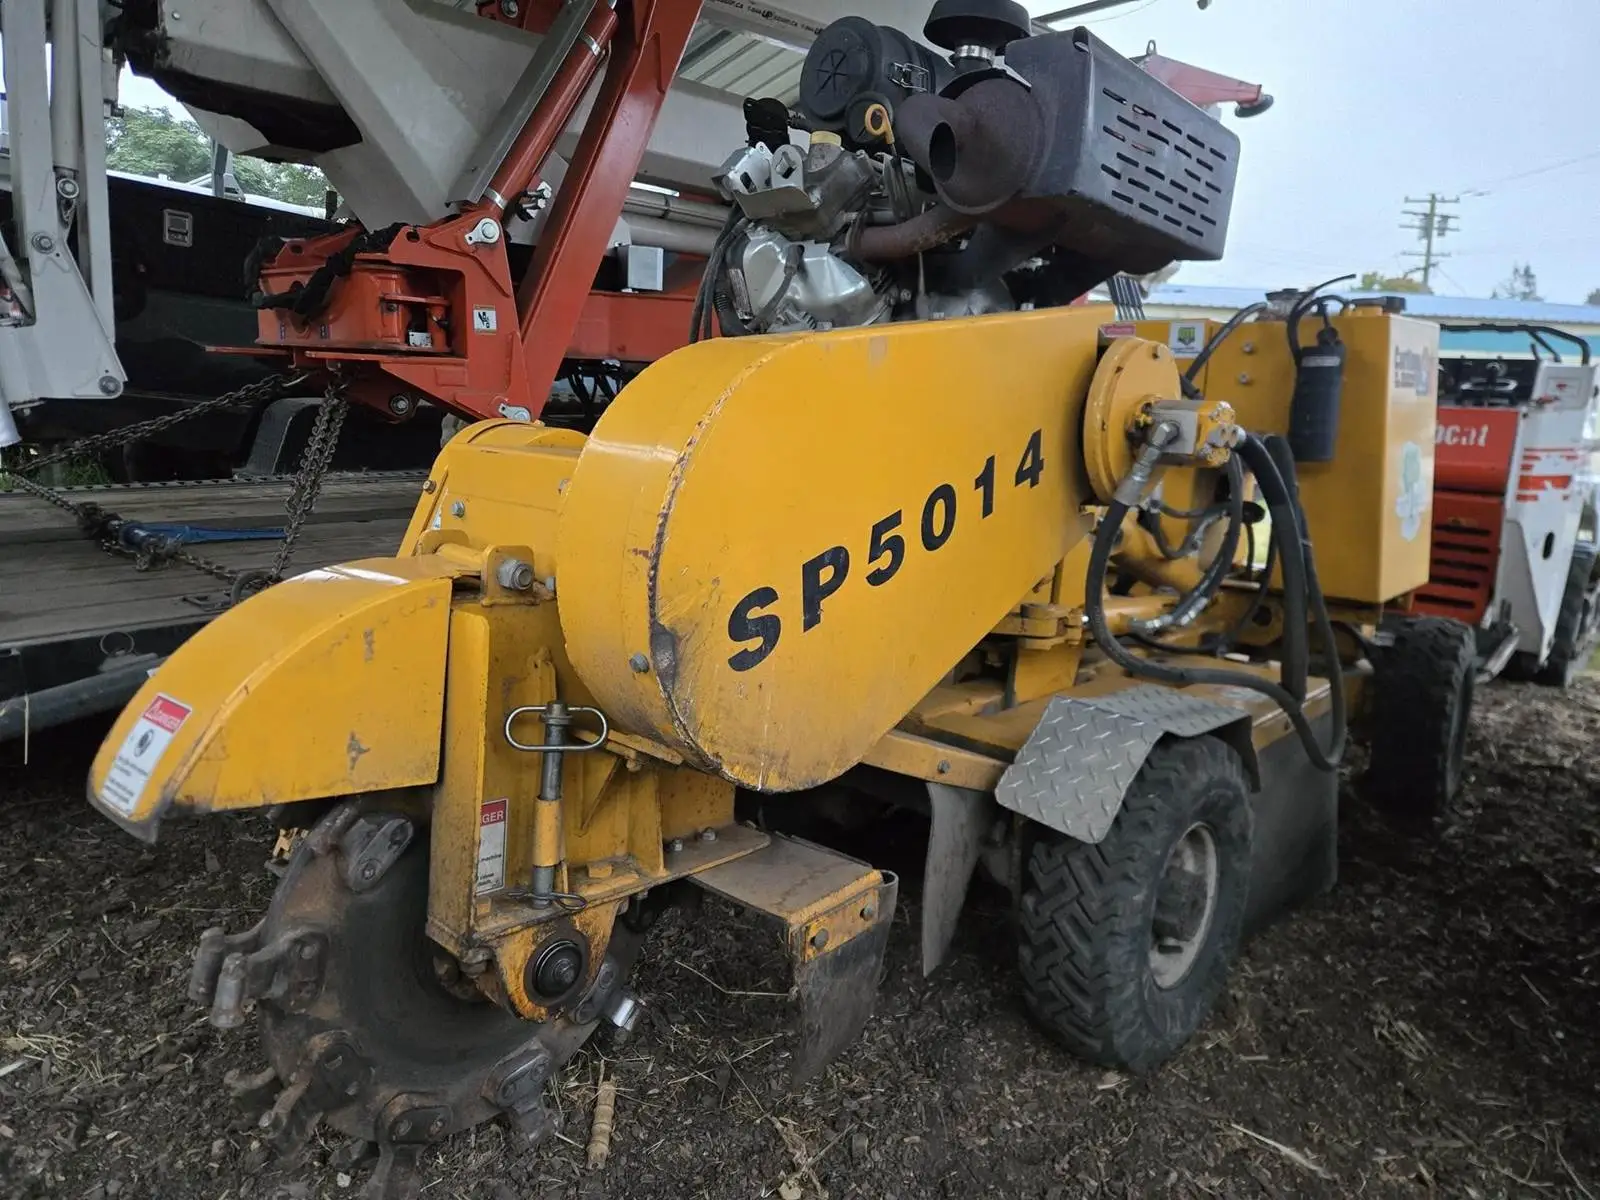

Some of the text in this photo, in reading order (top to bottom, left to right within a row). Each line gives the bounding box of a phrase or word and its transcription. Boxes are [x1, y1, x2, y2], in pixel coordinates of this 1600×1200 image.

[1436, 424, 1489, 447] cat
[728, 428, 1045, 672] SP5014
[482, 810, 504, 824] GER
